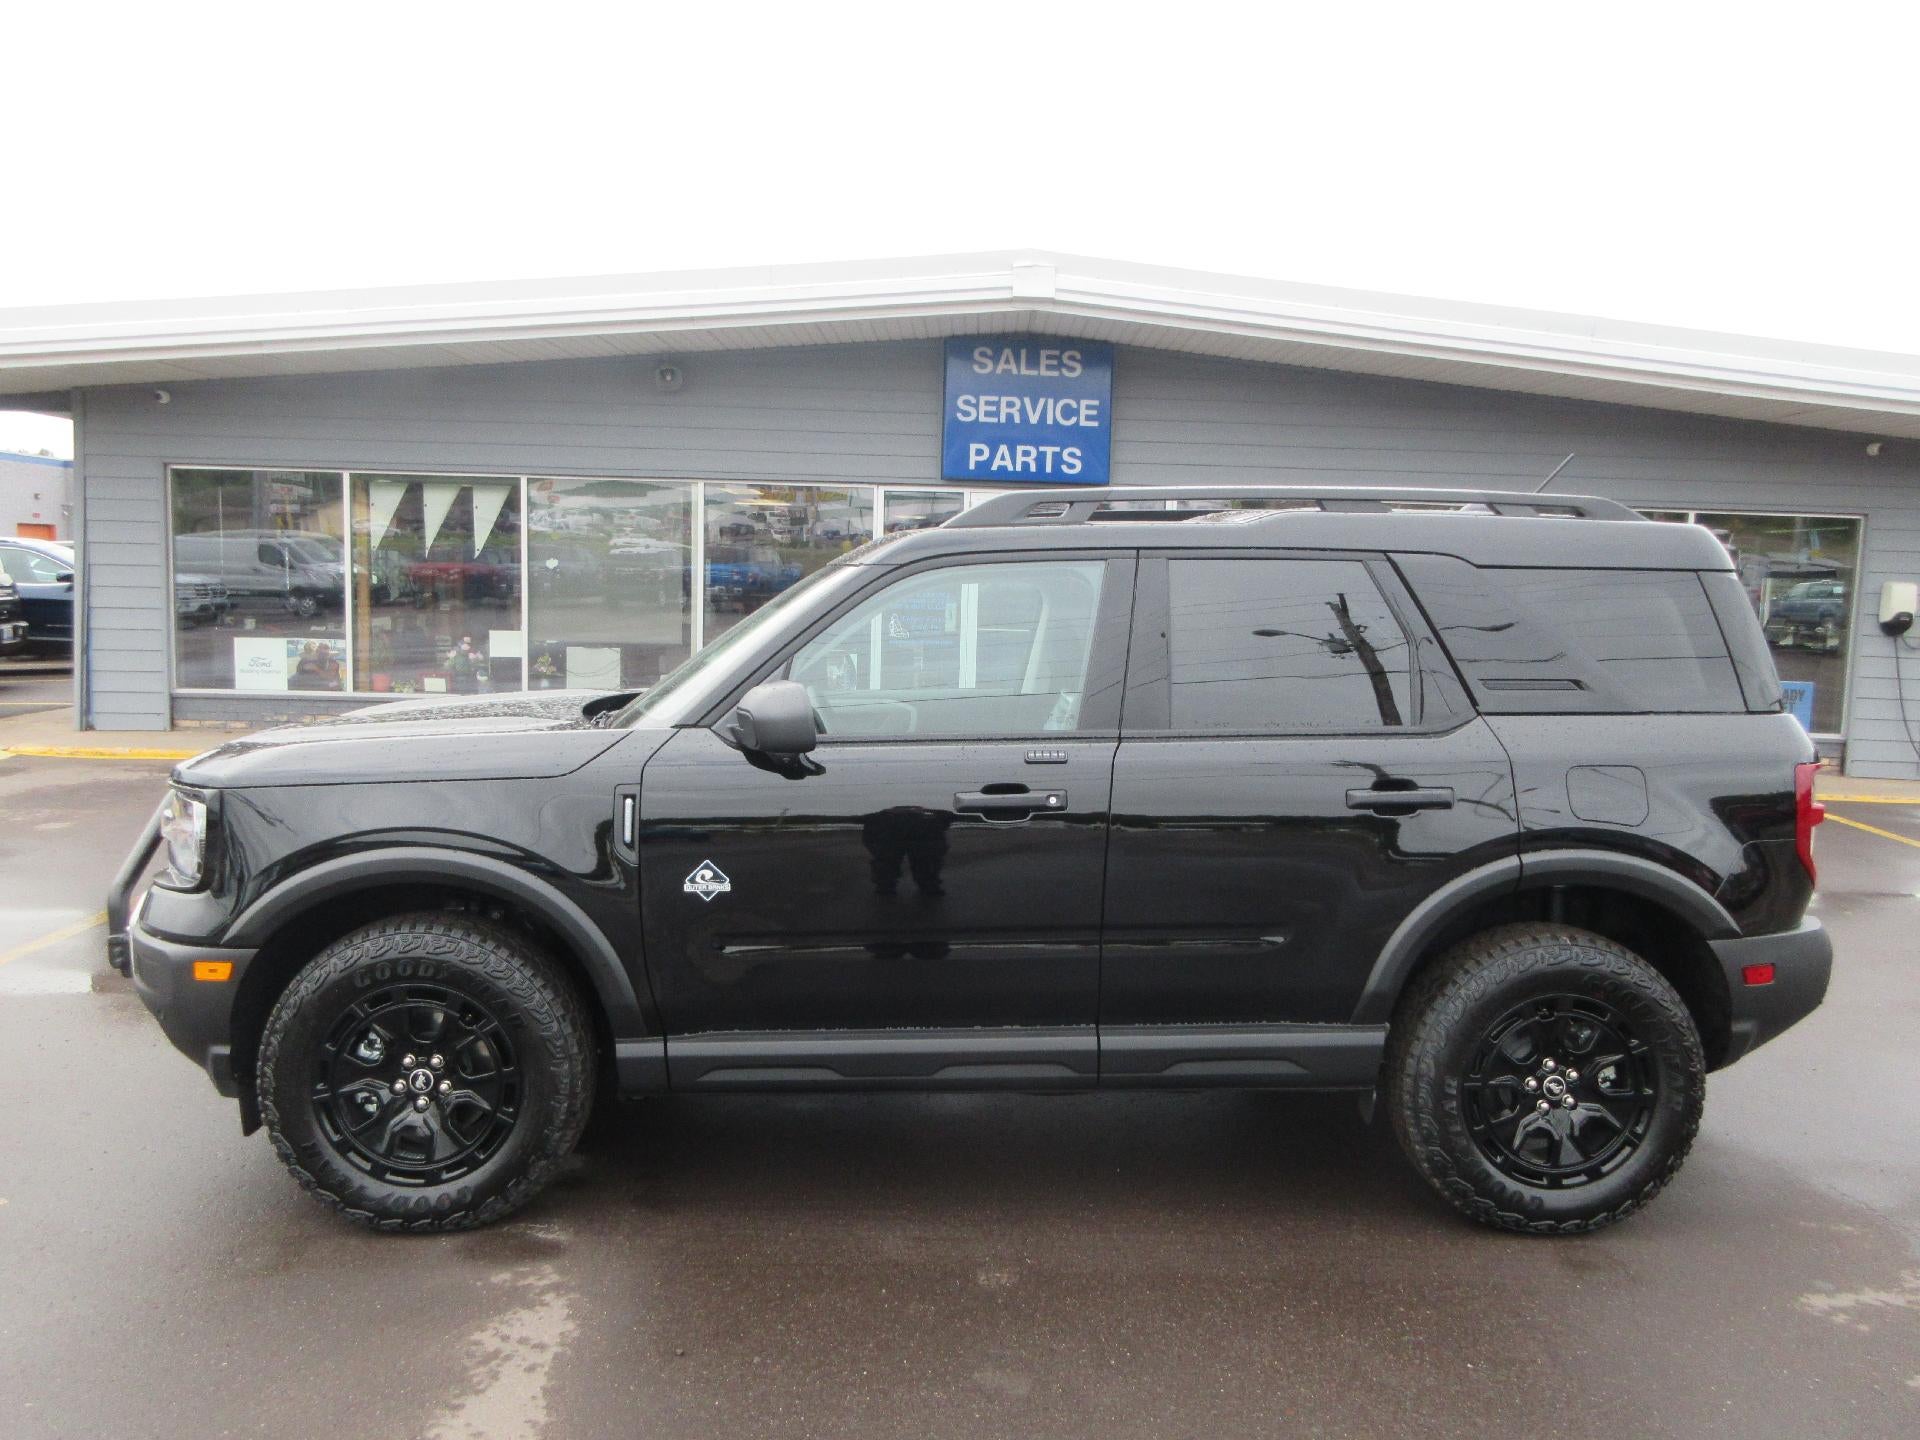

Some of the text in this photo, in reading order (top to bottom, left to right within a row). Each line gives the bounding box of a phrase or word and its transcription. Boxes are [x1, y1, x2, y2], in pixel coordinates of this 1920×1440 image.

[972, 347, 1083, 378] SALES
[956, 395, 1100, 427] SERVICE
[968, 443, 1083, 475] PARTS
[248, 656, 273, 668] Ford
